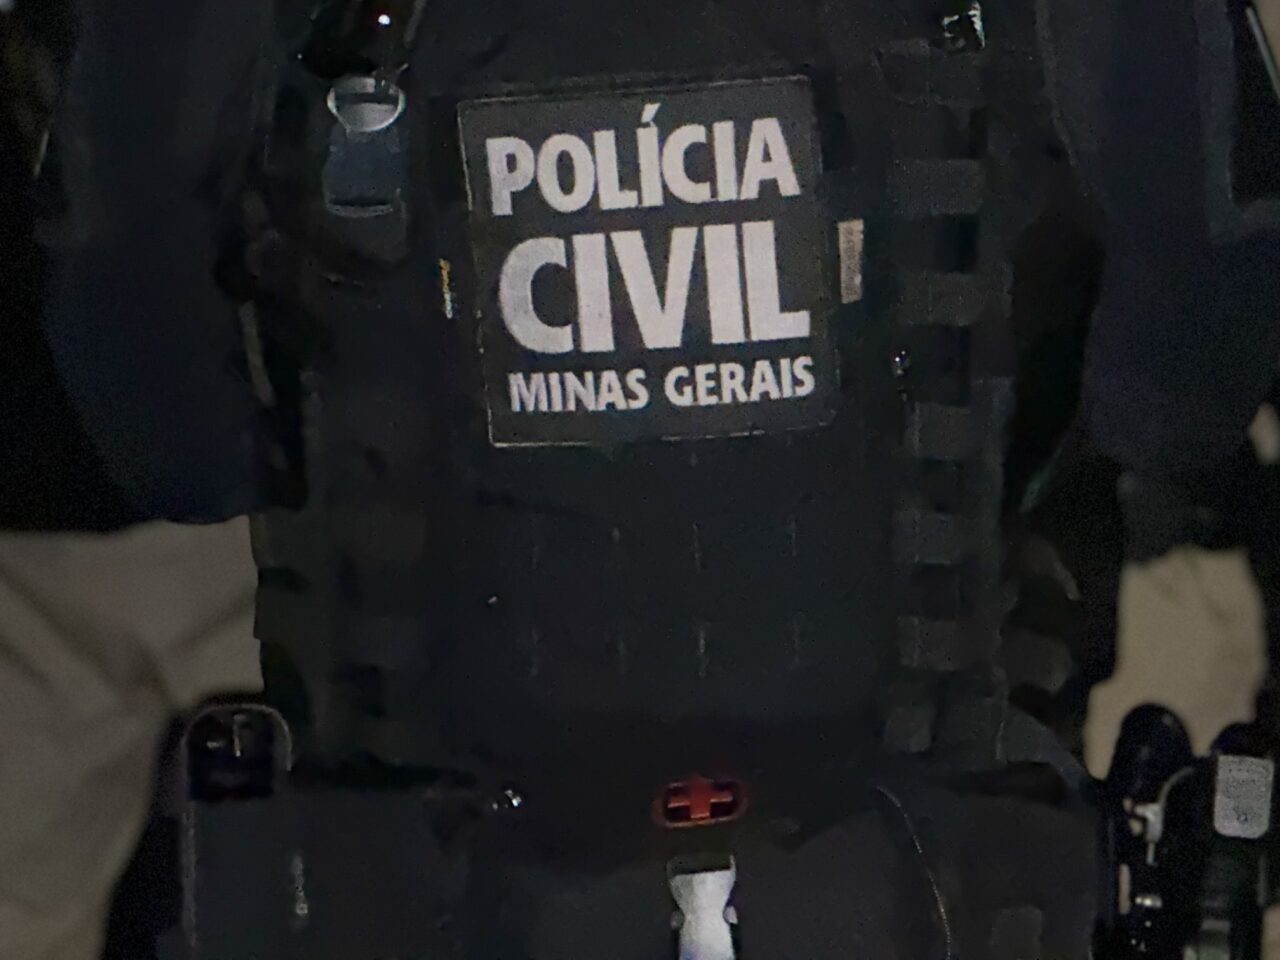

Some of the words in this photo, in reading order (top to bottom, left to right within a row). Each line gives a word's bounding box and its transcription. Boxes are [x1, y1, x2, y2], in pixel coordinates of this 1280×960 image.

[486, 102, 801, 216] POLÍCIA
[499, 220, 811, 355] CIVIL
[508, 368, 650, 413] MINAS
[664, 355, 816, 407] GERAIS
